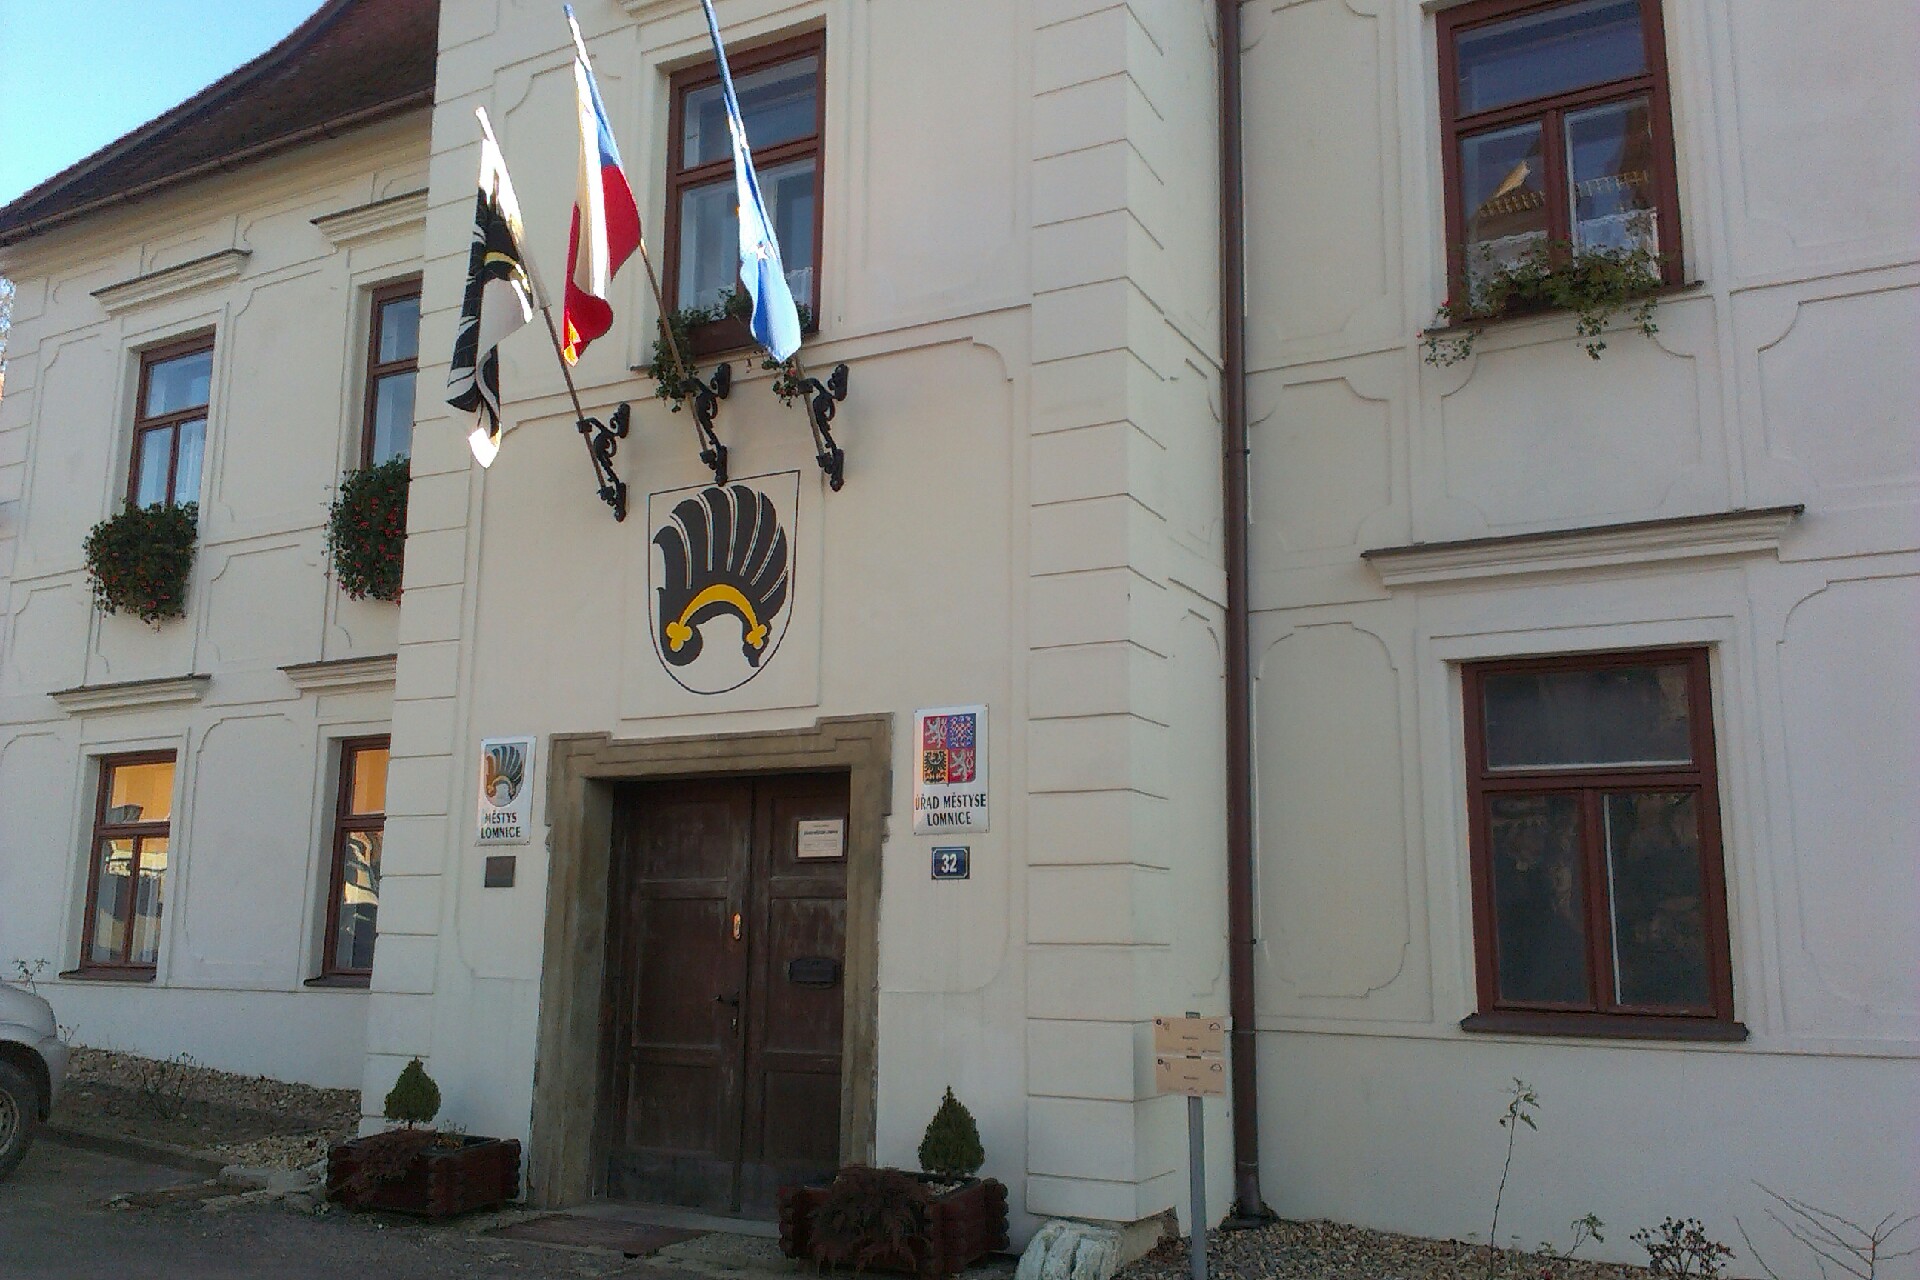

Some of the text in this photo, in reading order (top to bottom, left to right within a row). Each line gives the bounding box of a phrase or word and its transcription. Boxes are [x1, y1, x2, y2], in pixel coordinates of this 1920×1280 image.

[943, 792, 986, 809] MĚSTYSE
[927, 811, 972, 826] LOMNICE
[480, 826, 521, 839] LOMNICE
[941, 853, 957, 873] 32
